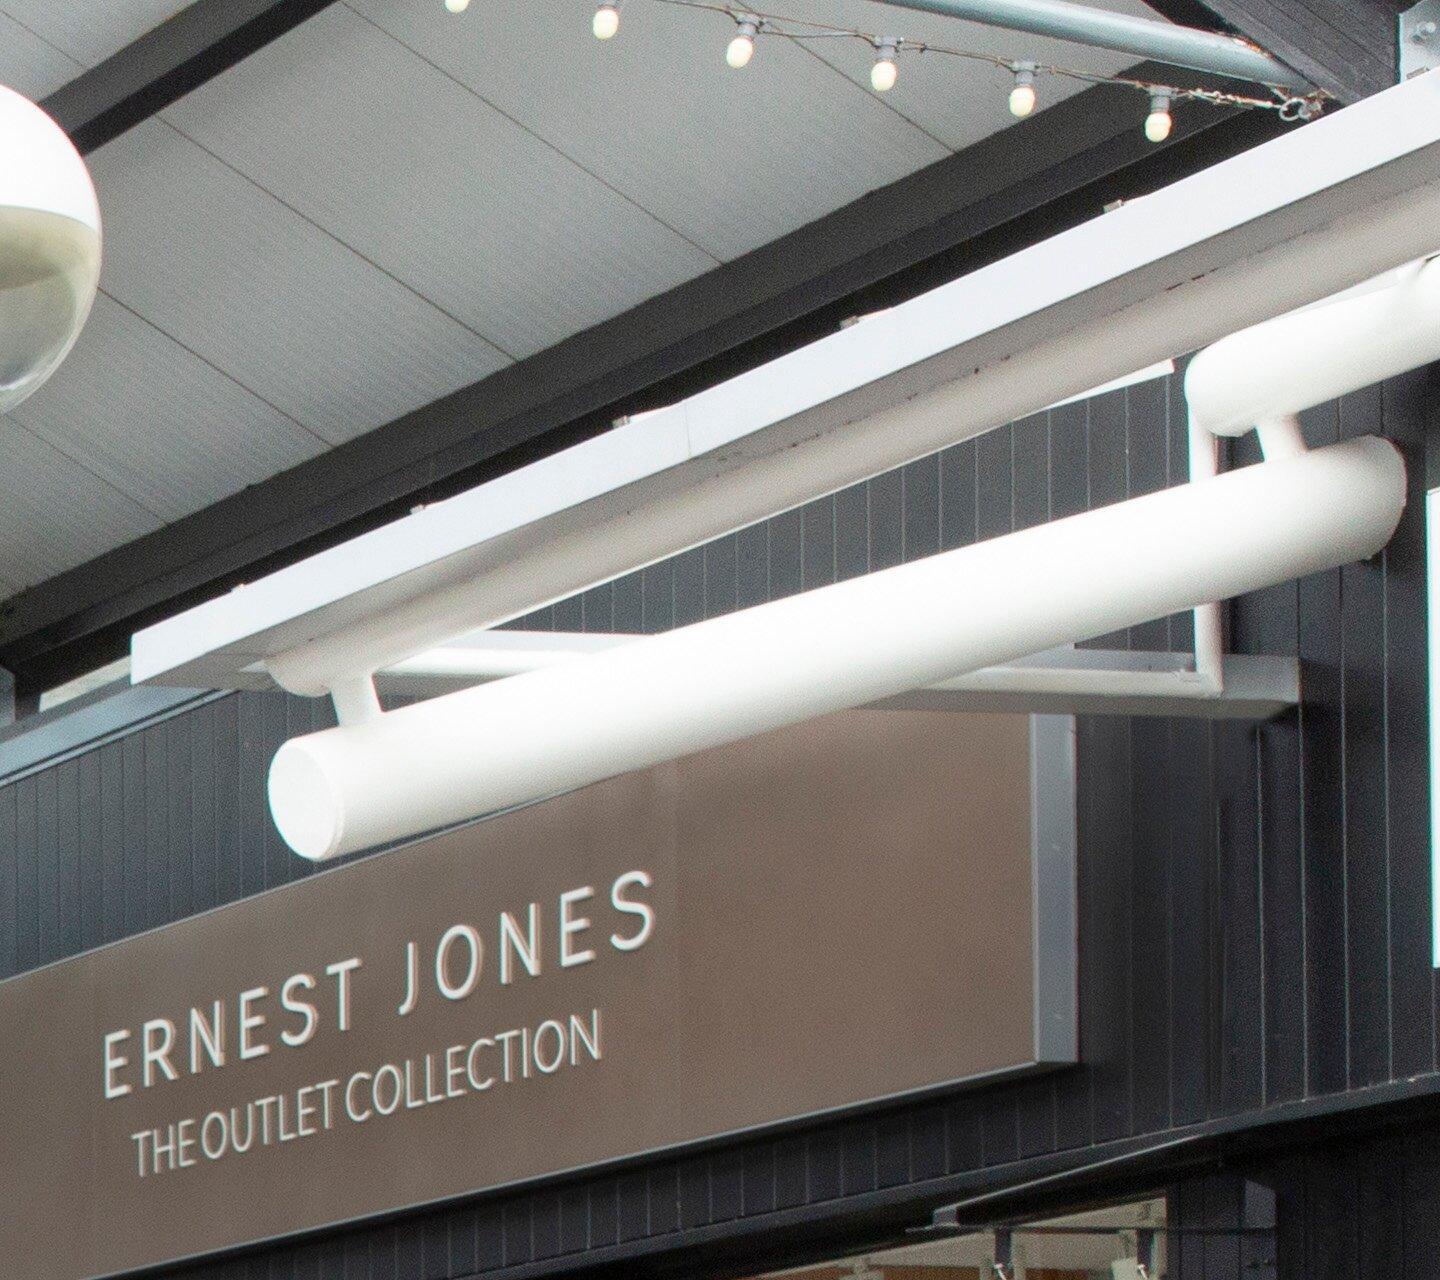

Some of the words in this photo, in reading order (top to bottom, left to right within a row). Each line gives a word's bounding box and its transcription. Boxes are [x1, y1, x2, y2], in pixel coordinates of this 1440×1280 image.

[102, 958, 363, 1100] ERNEST
[397, 869, 655, 1015] JONES
[130, 1117, 196, 1178] THE
[200, 1079, 340, 1160] OUTLET
[344, 1007, 603, 1123] COLLECTION
